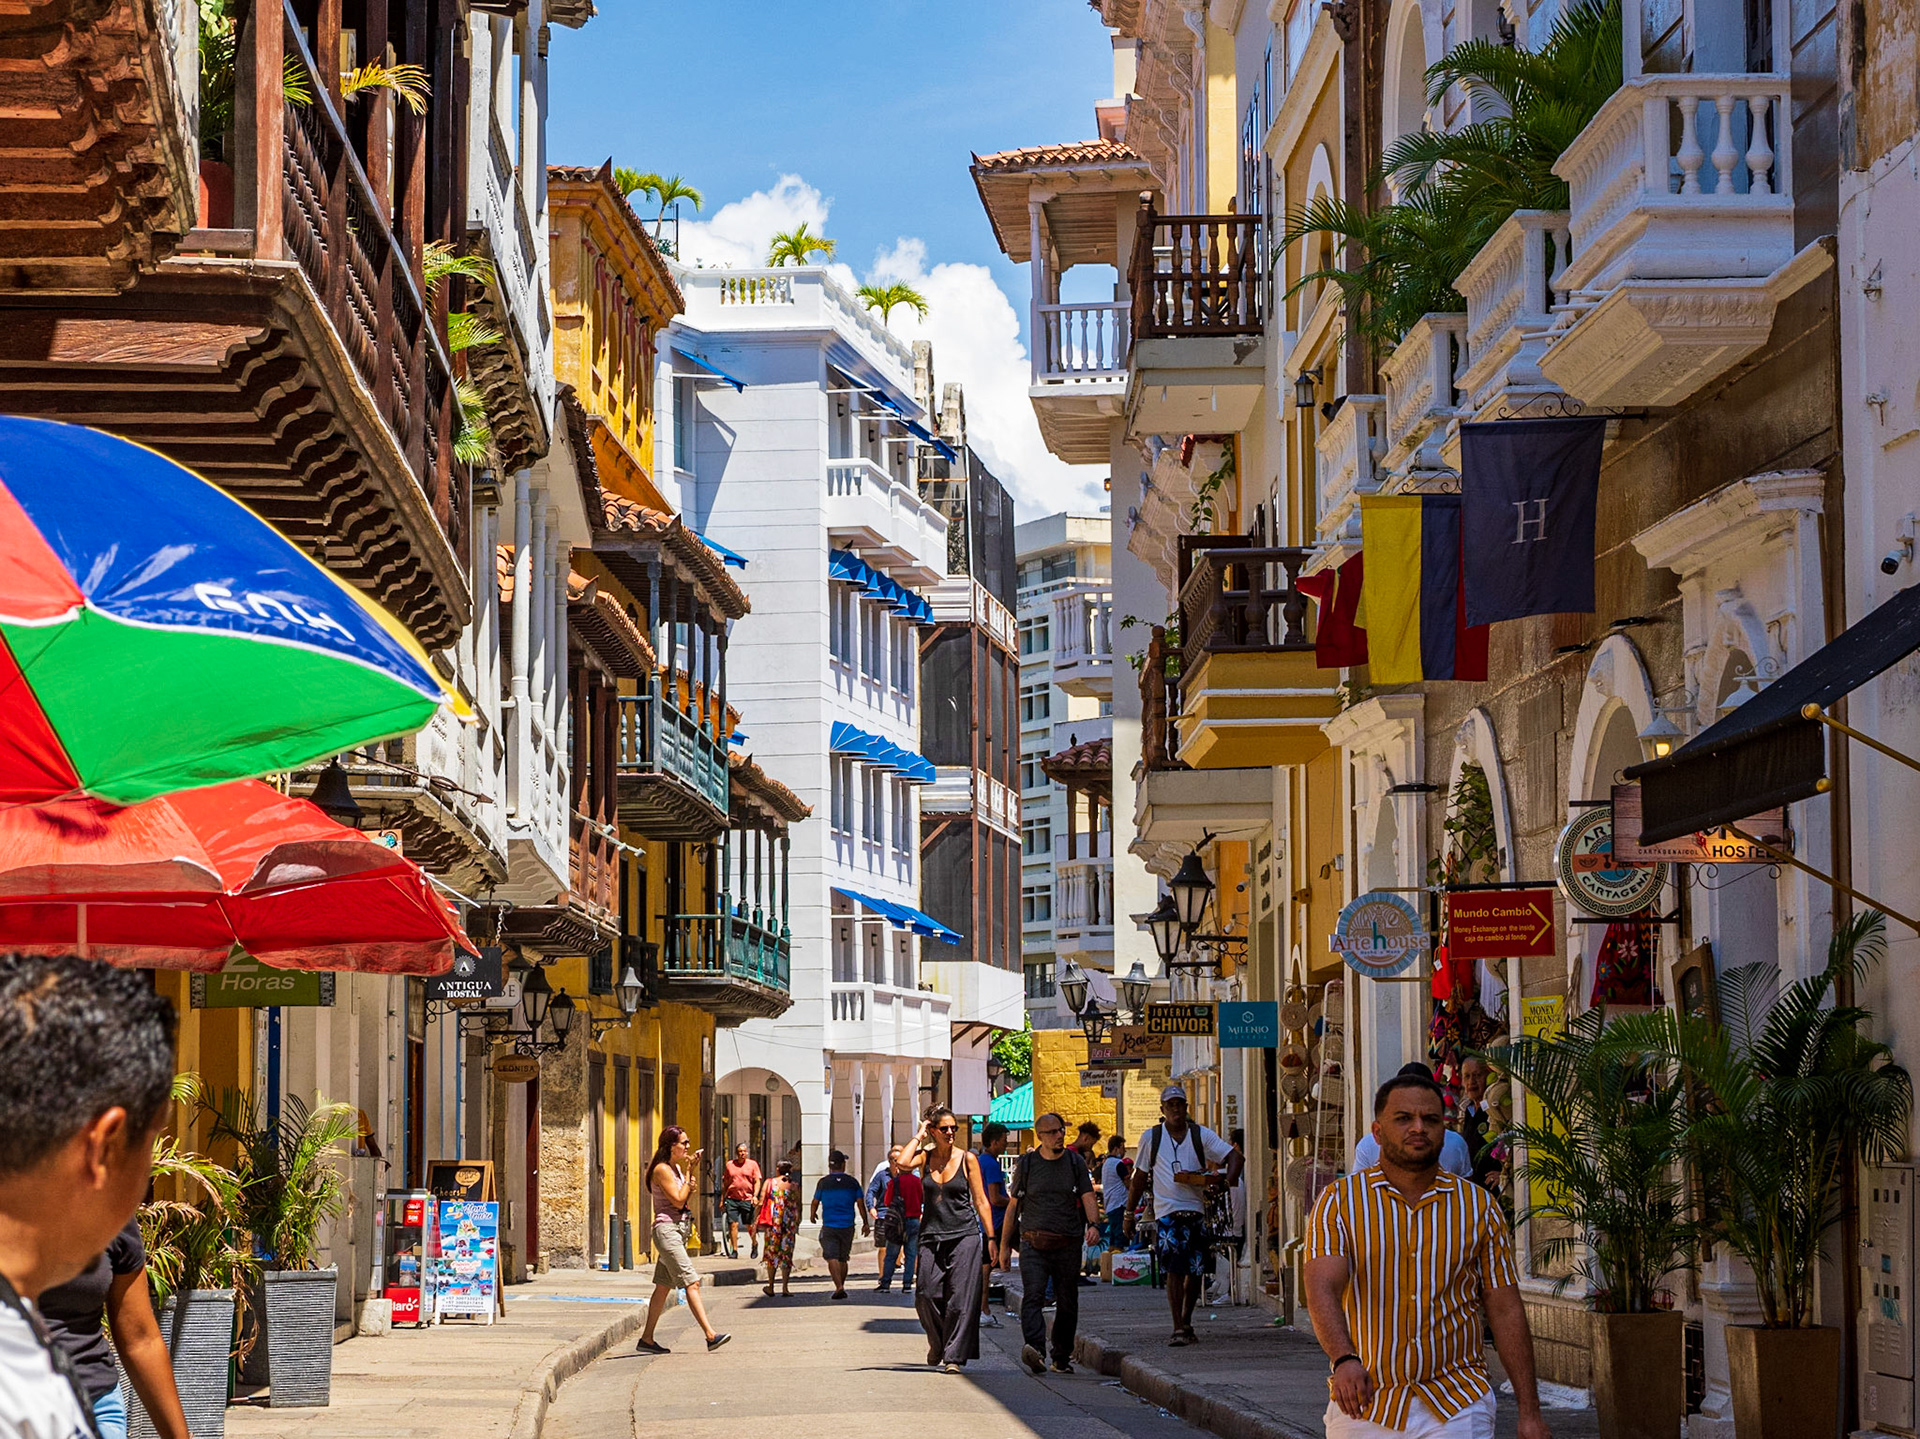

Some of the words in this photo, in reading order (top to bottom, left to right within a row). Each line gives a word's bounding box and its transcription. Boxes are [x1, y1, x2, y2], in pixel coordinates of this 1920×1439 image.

[1511, 498, 1549, 544] H
[1453, 908, 1489, 919] Mundo
[1492, 906, 1532, 917] Cambio
[1453, 926, 1471, 934] Money
[1472, 925, 1499, 934] Exchange
[220, 972, 294, 992] Horas
[437, 981, 492, 990] ANTIGUA
[447, 990, 482, 998] HOSTAL
[1529, 1006, 1555, 1016] MONEY
[1151, 1018, 1209, 1032] CHIVOR
[1228, 1025, 1269, 1035] MILENIO
[498, 1065, 535, 1073] LEONISA
[391, 1301, 414, 1312] laro
